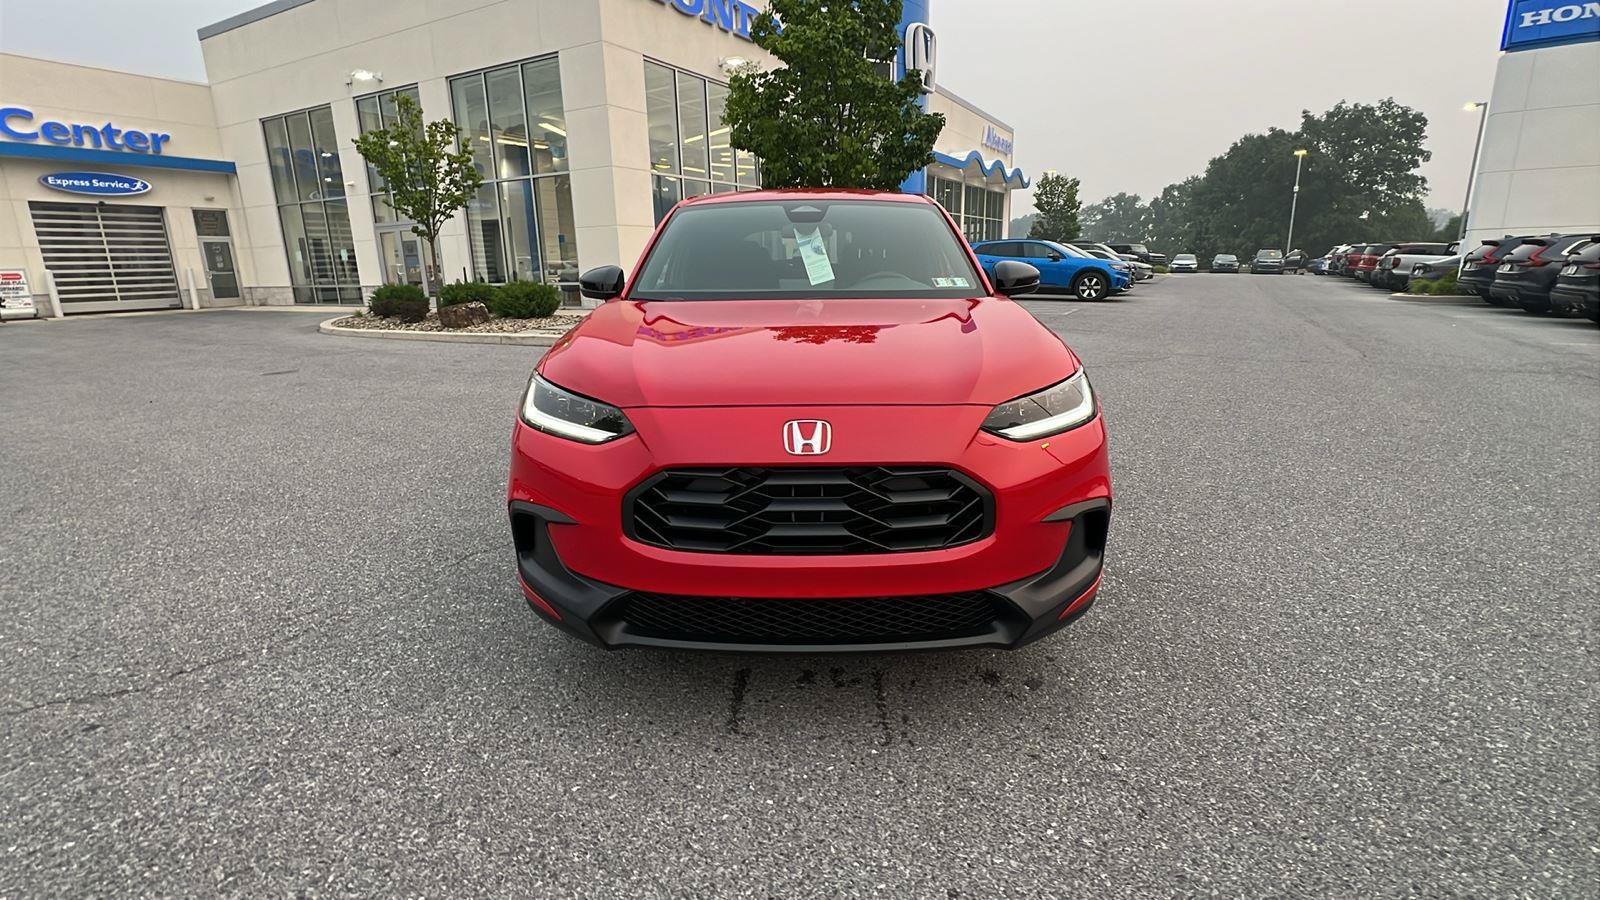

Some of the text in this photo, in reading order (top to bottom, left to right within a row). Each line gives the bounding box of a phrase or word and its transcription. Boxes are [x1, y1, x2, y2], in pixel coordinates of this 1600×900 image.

[0, 107, 171, 154] Center
[47, 176, 130, 189] Express Service
